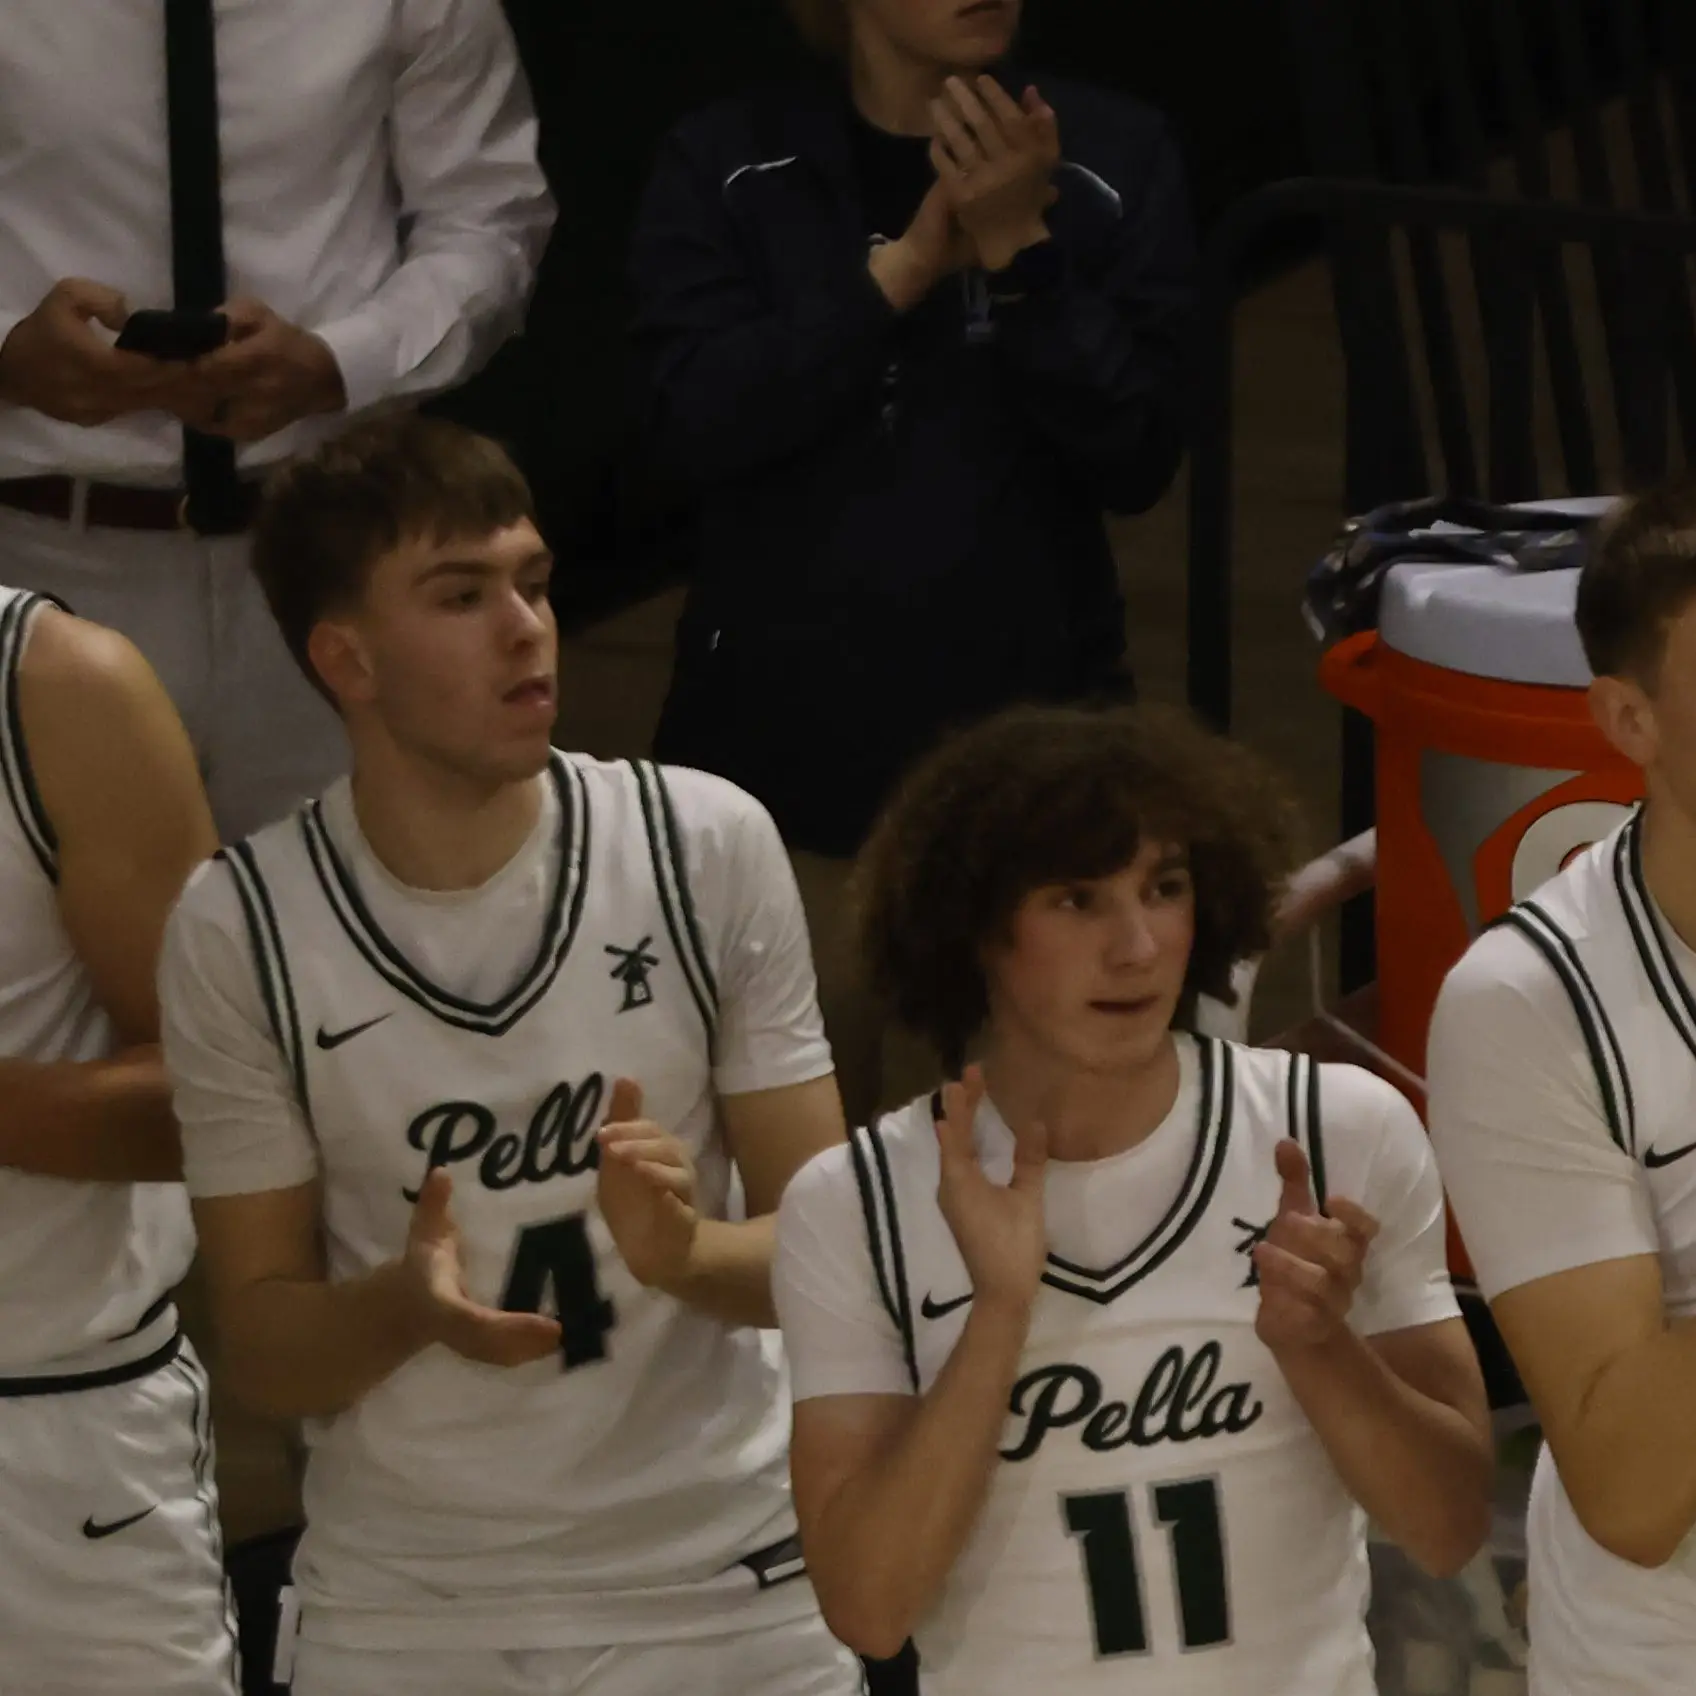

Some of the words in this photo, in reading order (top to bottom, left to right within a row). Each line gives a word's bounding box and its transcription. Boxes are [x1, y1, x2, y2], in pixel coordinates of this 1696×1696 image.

[402, 1071, 605, 1204] Pell
[500, 1211, 615, 1372] 4
[1000, 1340, 1263, 1462] Pella
[1060, 1474, 1232, 1660] 11
